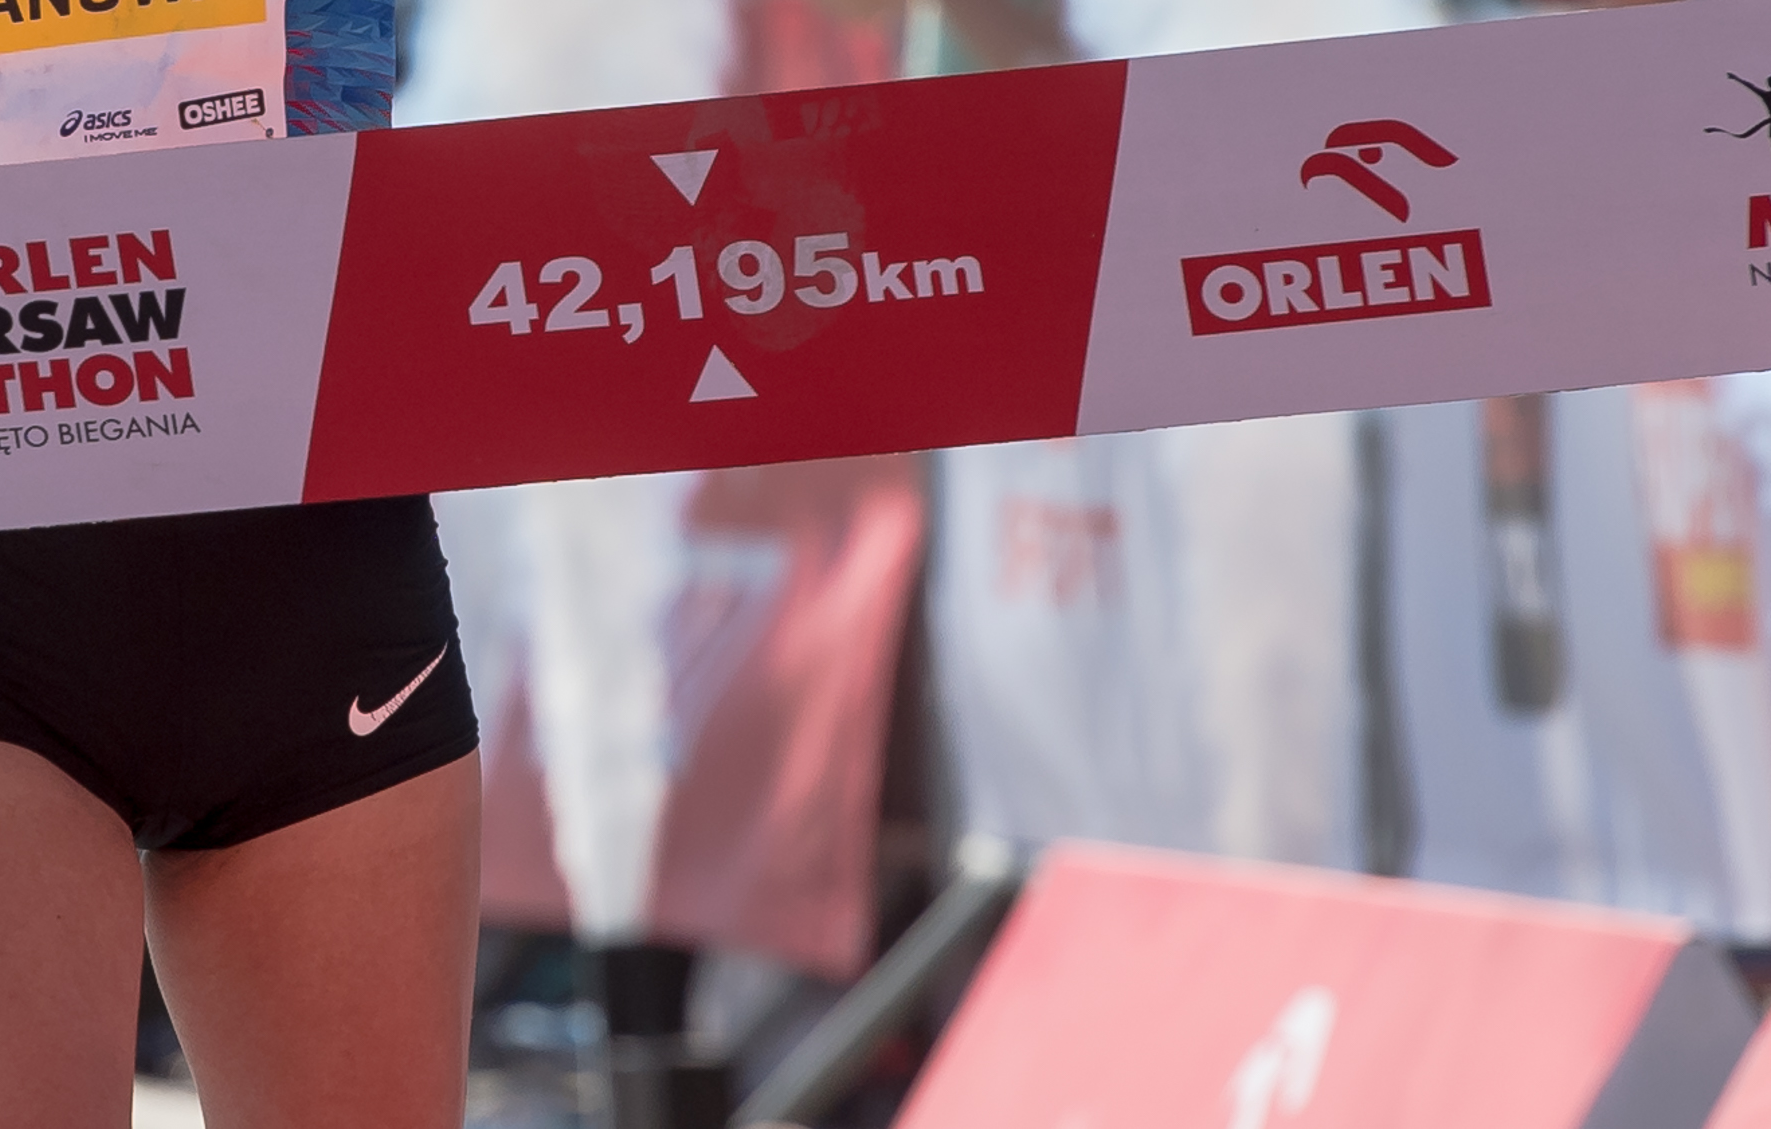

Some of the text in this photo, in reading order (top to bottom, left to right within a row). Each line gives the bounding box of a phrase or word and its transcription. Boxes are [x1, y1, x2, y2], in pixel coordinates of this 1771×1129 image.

[183, 92, 261, 125] OSHEE
[1200, 242, 1471, 322] ORLEN
[58, 411, 202, 445] BIEGANIA
